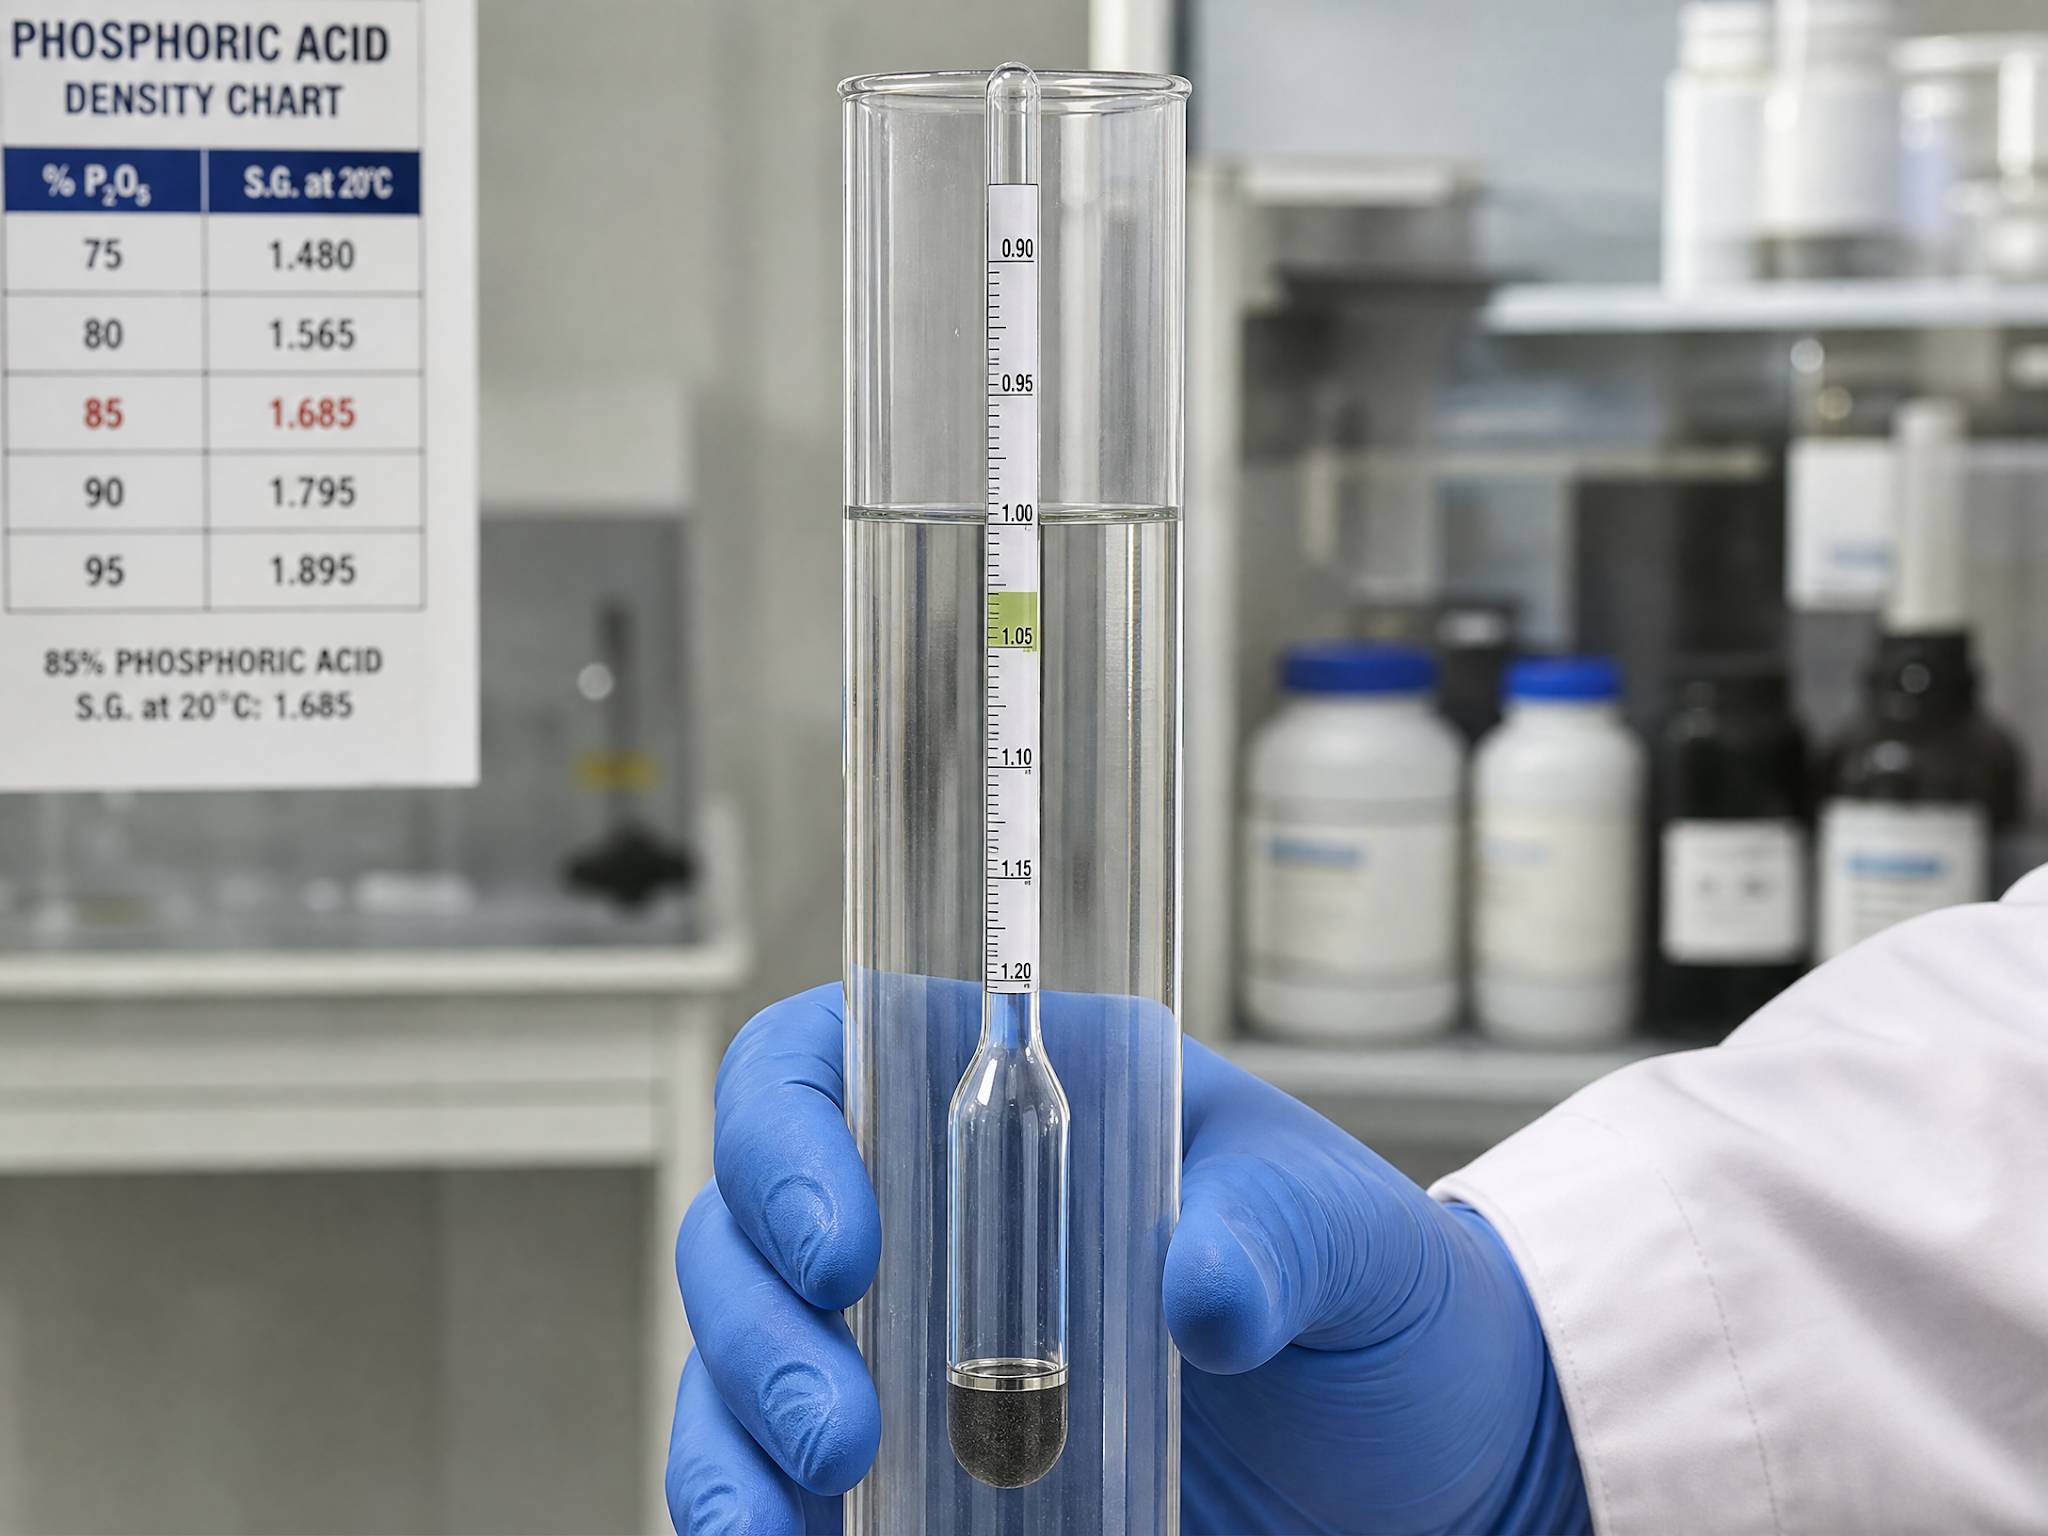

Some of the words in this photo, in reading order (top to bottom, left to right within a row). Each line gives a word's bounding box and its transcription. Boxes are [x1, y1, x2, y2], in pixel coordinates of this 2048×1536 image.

[13, 20, 281, 61] PHOSPHORIC
[296, 25, 389, 62] ACID
[65, 82, 213, 115] DENSITY
[227, 84, 343, 117] CHART
[42, 164, 75, 197] %
[244, 166, 299, 198] S.G.
[305, 169, 335, 197] at
[84, 238, 122, 270] 75
[270, 241, 355, 270] 1.480
[1002, 238, 1034, 258] 0.90
[84, 319, 123, 349] 80
[270, 319, 355, 349] 1.565
[1002, 373, 1033, 393] 0.95
[84, 398, 123, 429] 85
[270, 398, 355, 429] 1.685
[84, 477, 124, 507] 90
[270, 476, 355, 507] 1.795
[1002, 504, 1033, 522] 1.00
[84, 556, 124, 586] 95
[270, 555, 355, 585] 1.895
[1002, 627, 1032, 644] 1.05
[44, 651, 104, 676] 85%
[115, 649, 305, 676] PHOSPHORIC
[315, 648, 382, 674] ACID
[76, 694, 132, 720] S.G.
[142, 695, 168, 719] at
[181, 692, 260, 719] 20°C:
[275, 691, 353, 719] 1.685
[1001, 748, 1032, 766] 1.10
[1001, 859, 1031, 877] 1.15
[1001, 962, 1031, 980] 1.20
